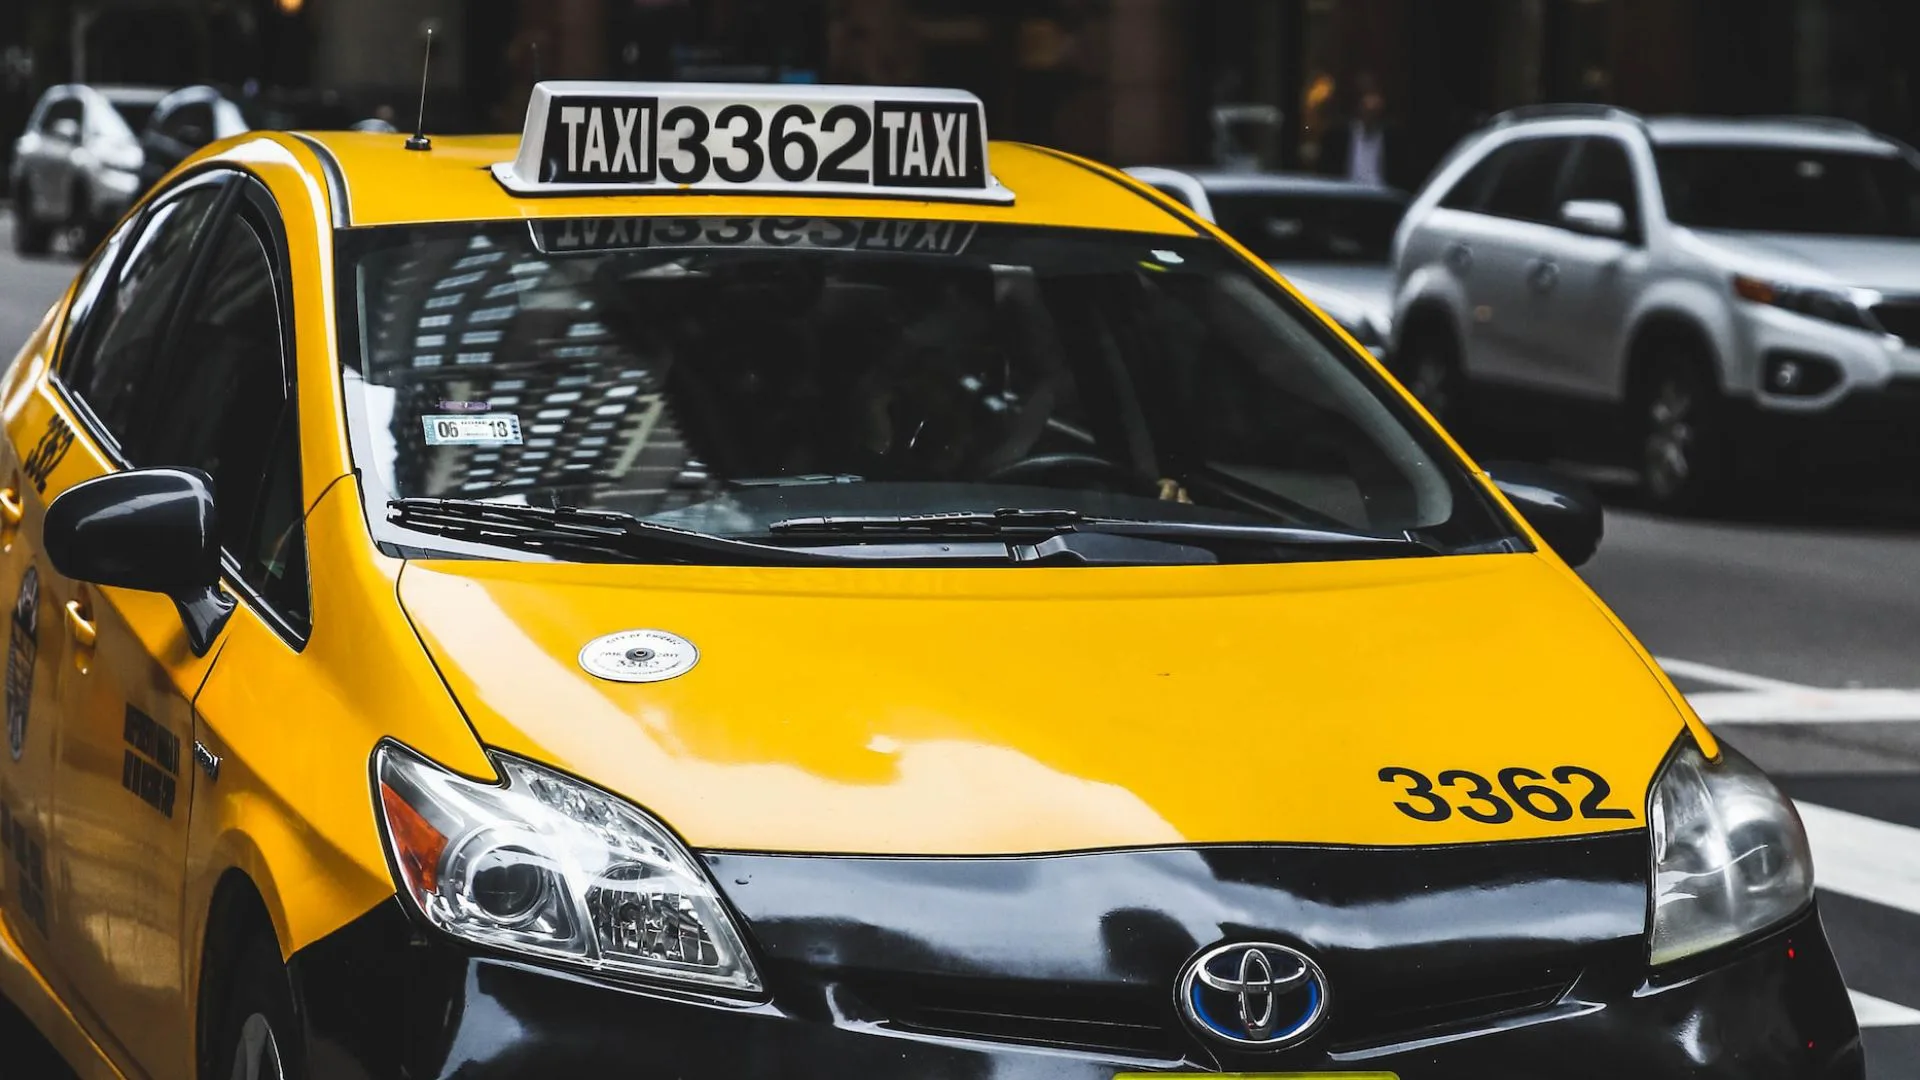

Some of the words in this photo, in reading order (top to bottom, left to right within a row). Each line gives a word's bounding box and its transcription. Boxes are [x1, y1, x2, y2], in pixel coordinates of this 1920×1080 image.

[561, 106, 649, 174] TAXI
[659, 104, 872, 184] 3362
[882, 111, 968, 176] TAXI
[438, 421, 459, 438] 06
[489, 421, 508, 438] 18
[1378, 765, 1636, 824] 3362
